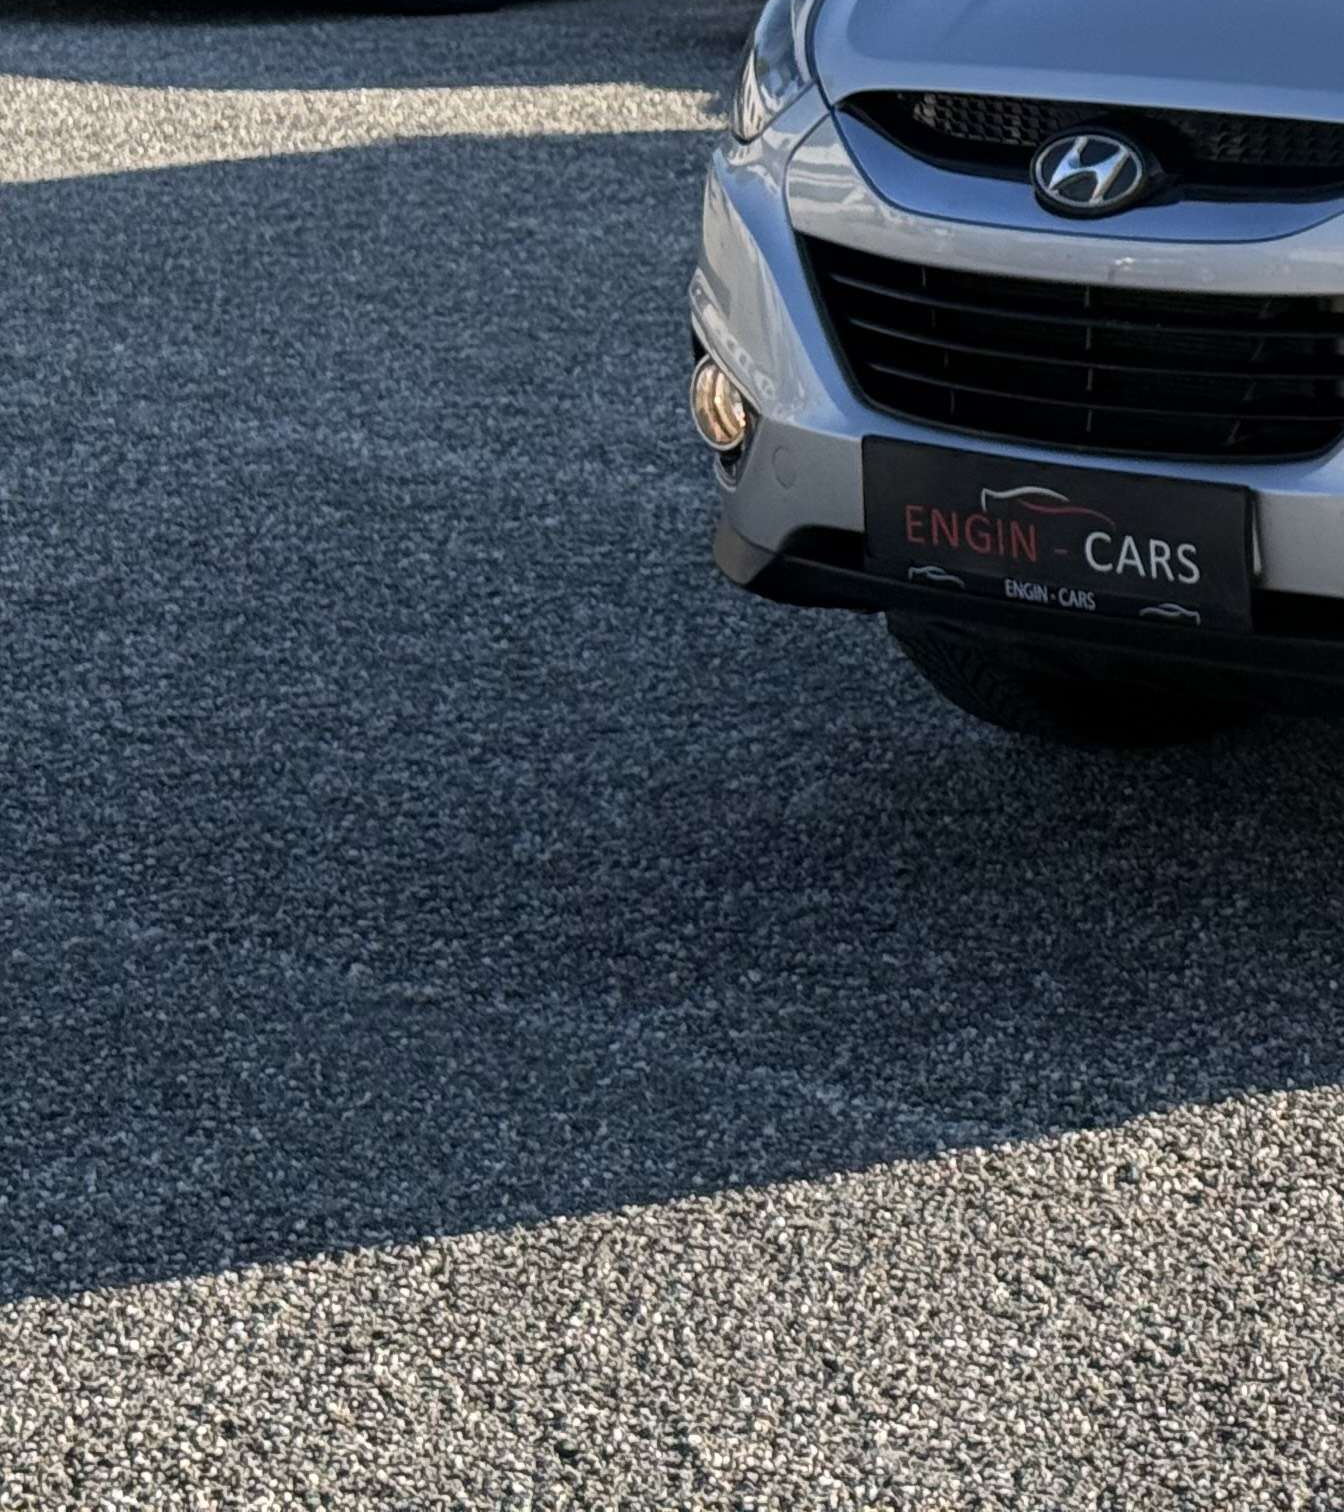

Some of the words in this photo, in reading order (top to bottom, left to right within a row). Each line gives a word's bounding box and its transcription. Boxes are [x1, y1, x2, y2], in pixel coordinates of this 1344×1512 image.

[904, 504, 1039, 563] ENGIN
[1084, 531, 1200, 585] CARS
[1004, 578, 1049, 604] ENGIN
[1058, 588, 1096, 611] CARS
